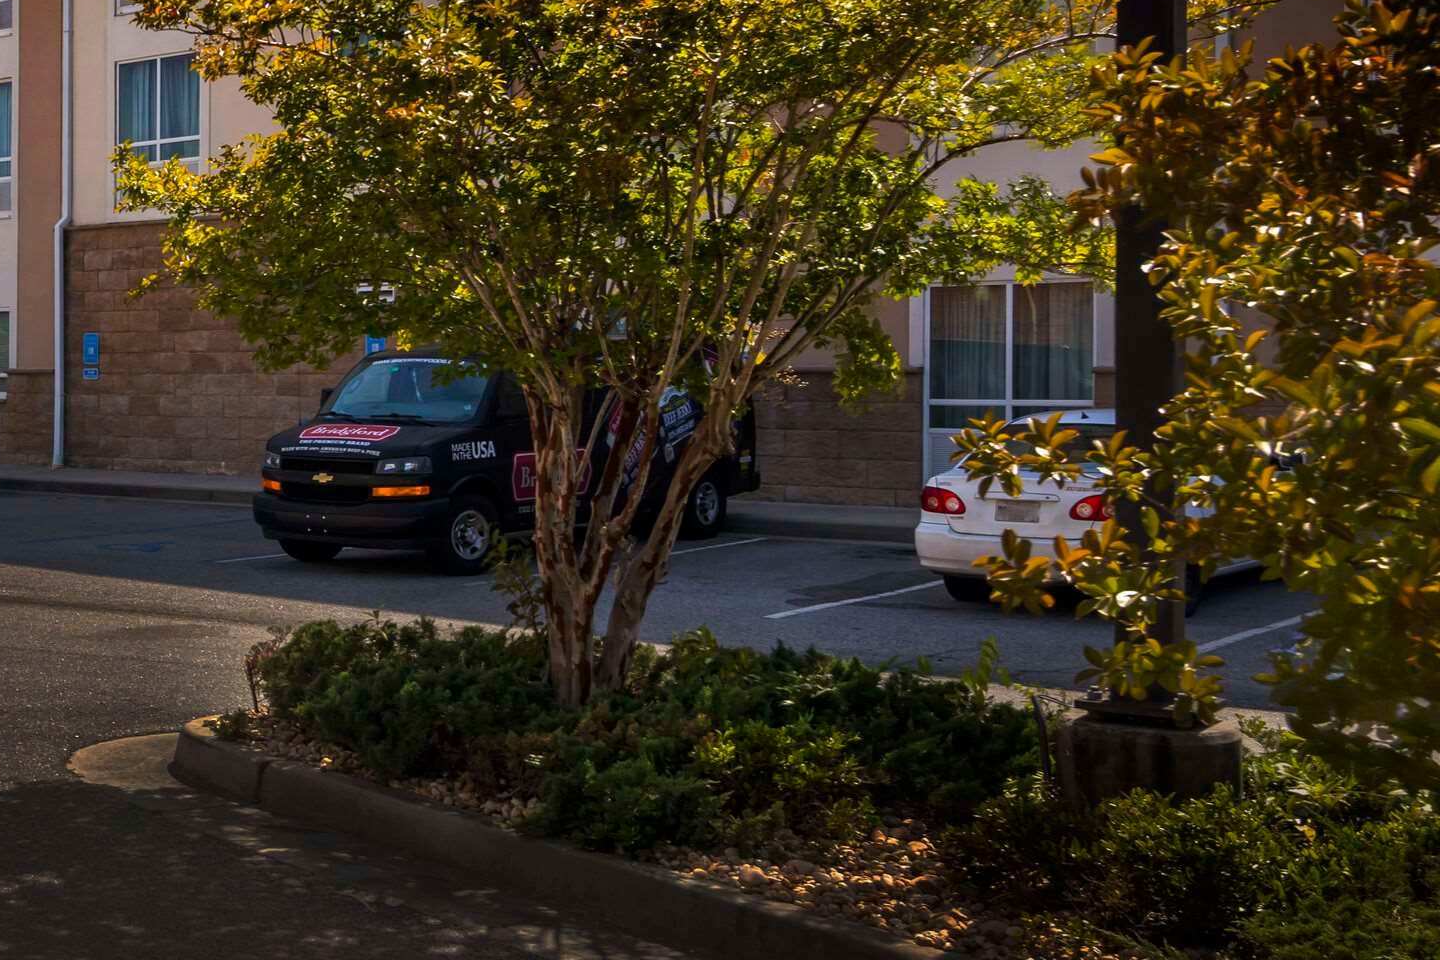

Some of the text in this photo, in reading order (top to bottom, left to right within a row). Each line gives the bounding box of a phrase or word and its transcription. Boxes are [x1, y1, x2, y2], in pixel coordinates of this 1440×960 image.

[311, 426, 389, 437] Bridgford
[451, 442, 471, 452] MADE
[471, 440, 496, 459] USA
